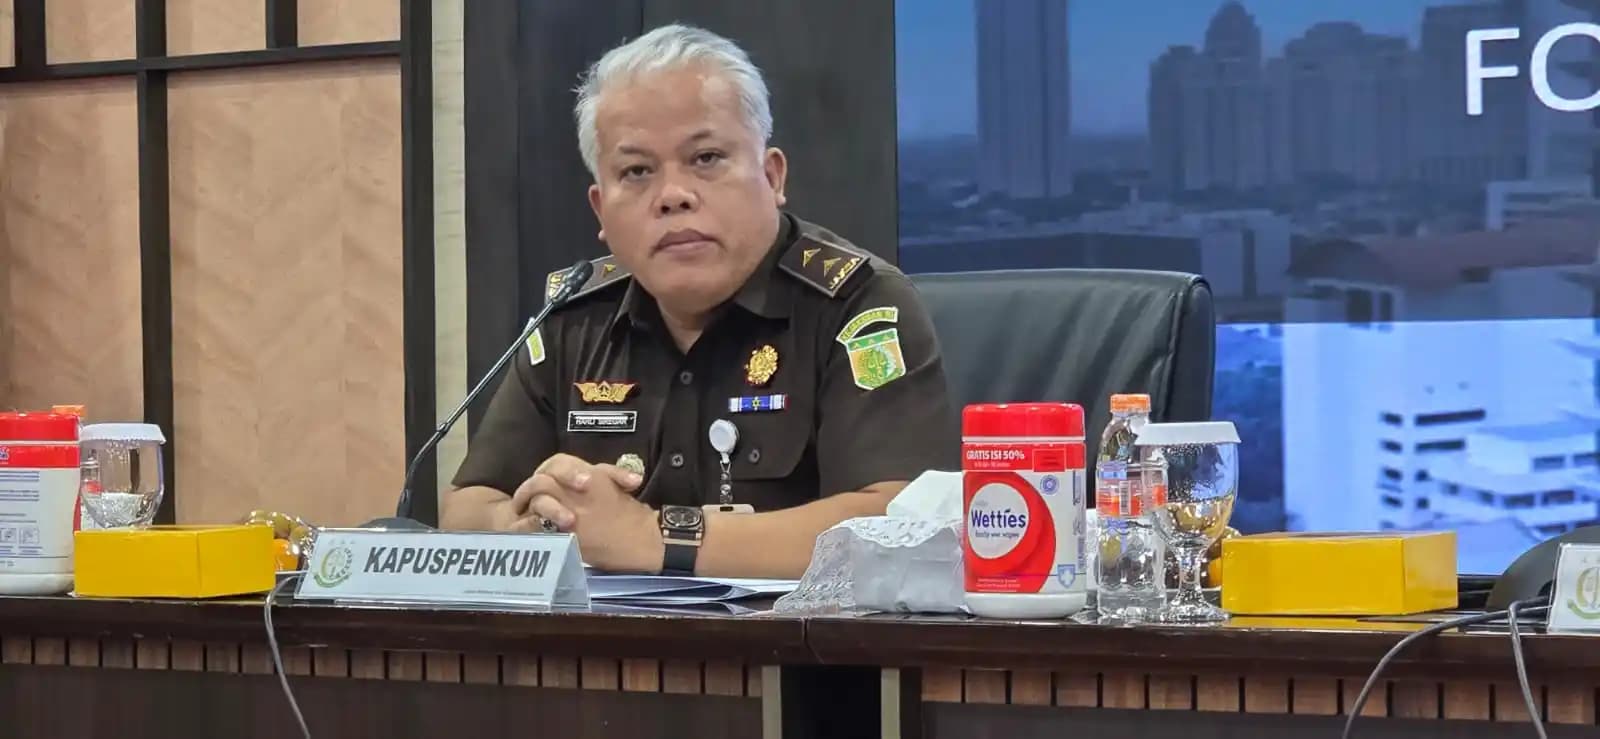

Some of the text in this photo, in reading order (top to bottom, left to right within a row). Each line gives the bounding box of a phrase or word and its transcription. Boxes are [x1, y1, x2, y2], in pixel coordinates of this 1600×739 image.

[966, 450, 1025, 460] GRATIS ISI 50%
[971, 508, 1026, 529] Wetties
[364, 546, 551, 578] KAPUSPENKUM
